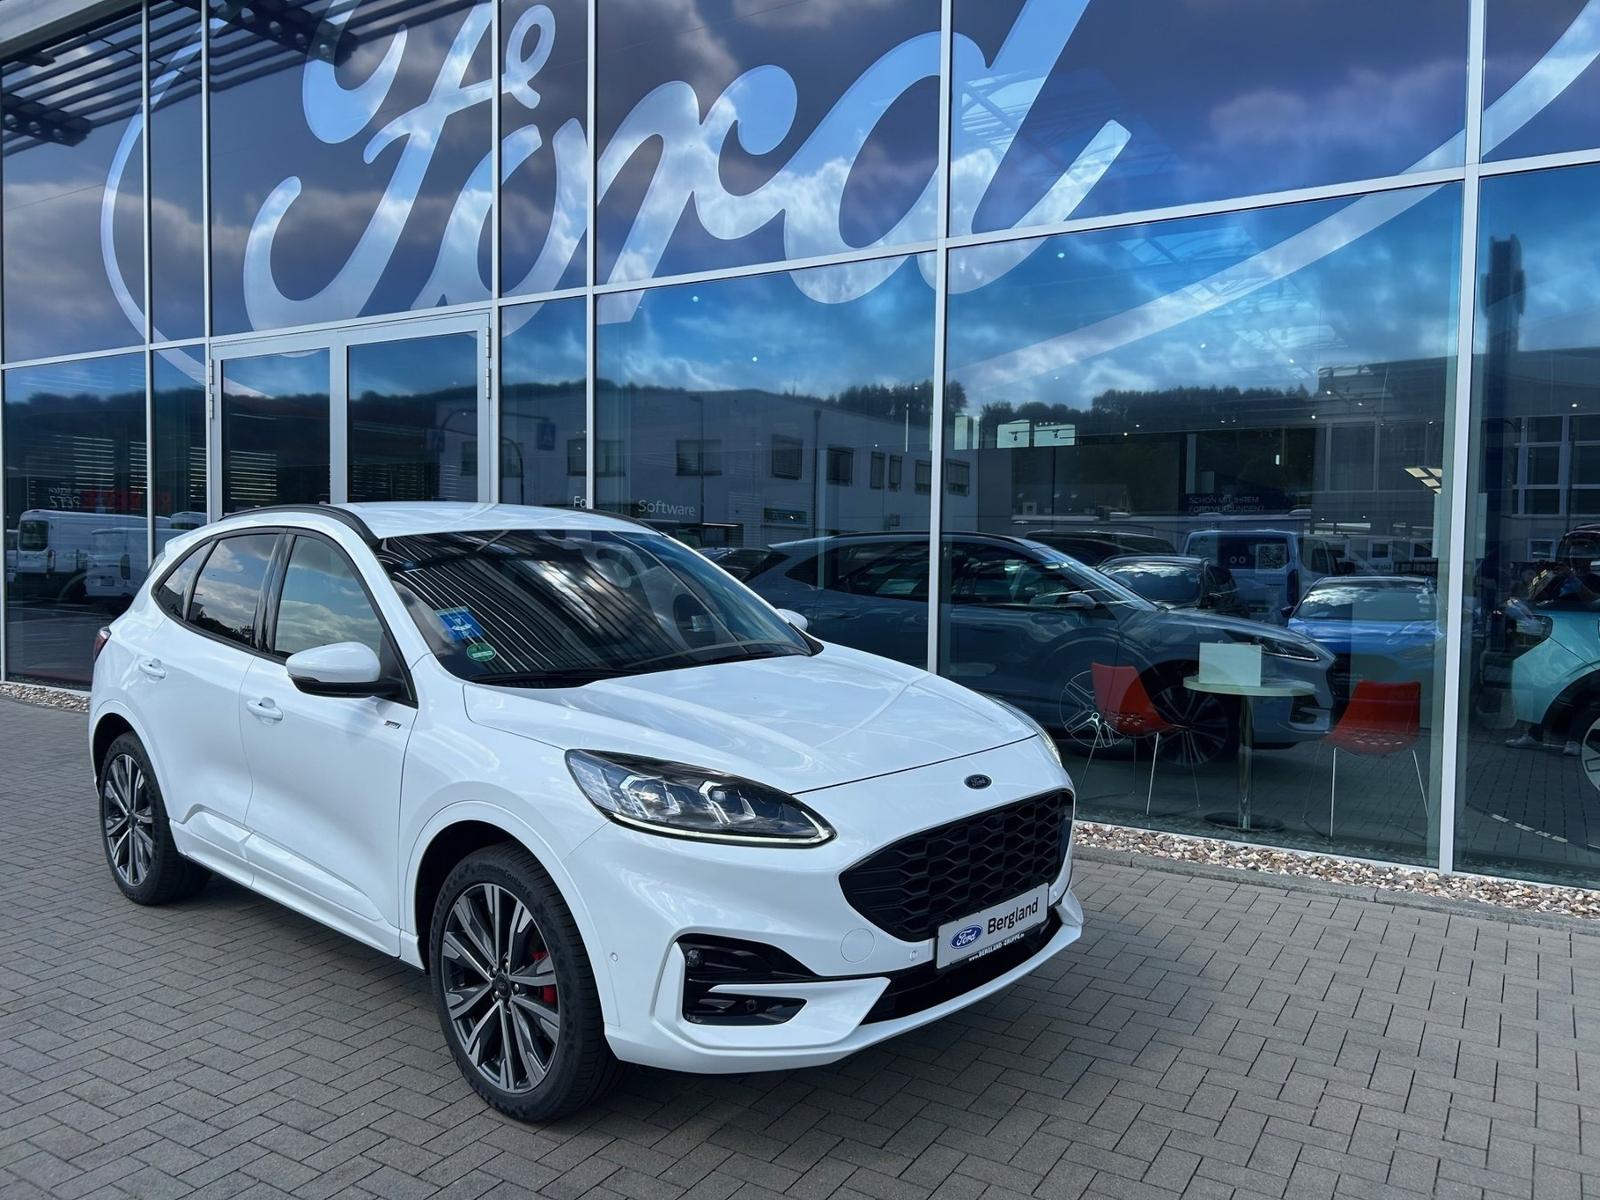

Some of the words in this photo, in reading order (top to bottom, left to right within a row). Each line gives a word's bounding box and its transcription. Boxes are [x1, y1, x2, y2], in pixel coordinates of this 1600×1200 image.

[243, 0, 1131, 357] Ford
[638, 499, 696, 516] Software
[987, 896, 1039, 935] Bergland
